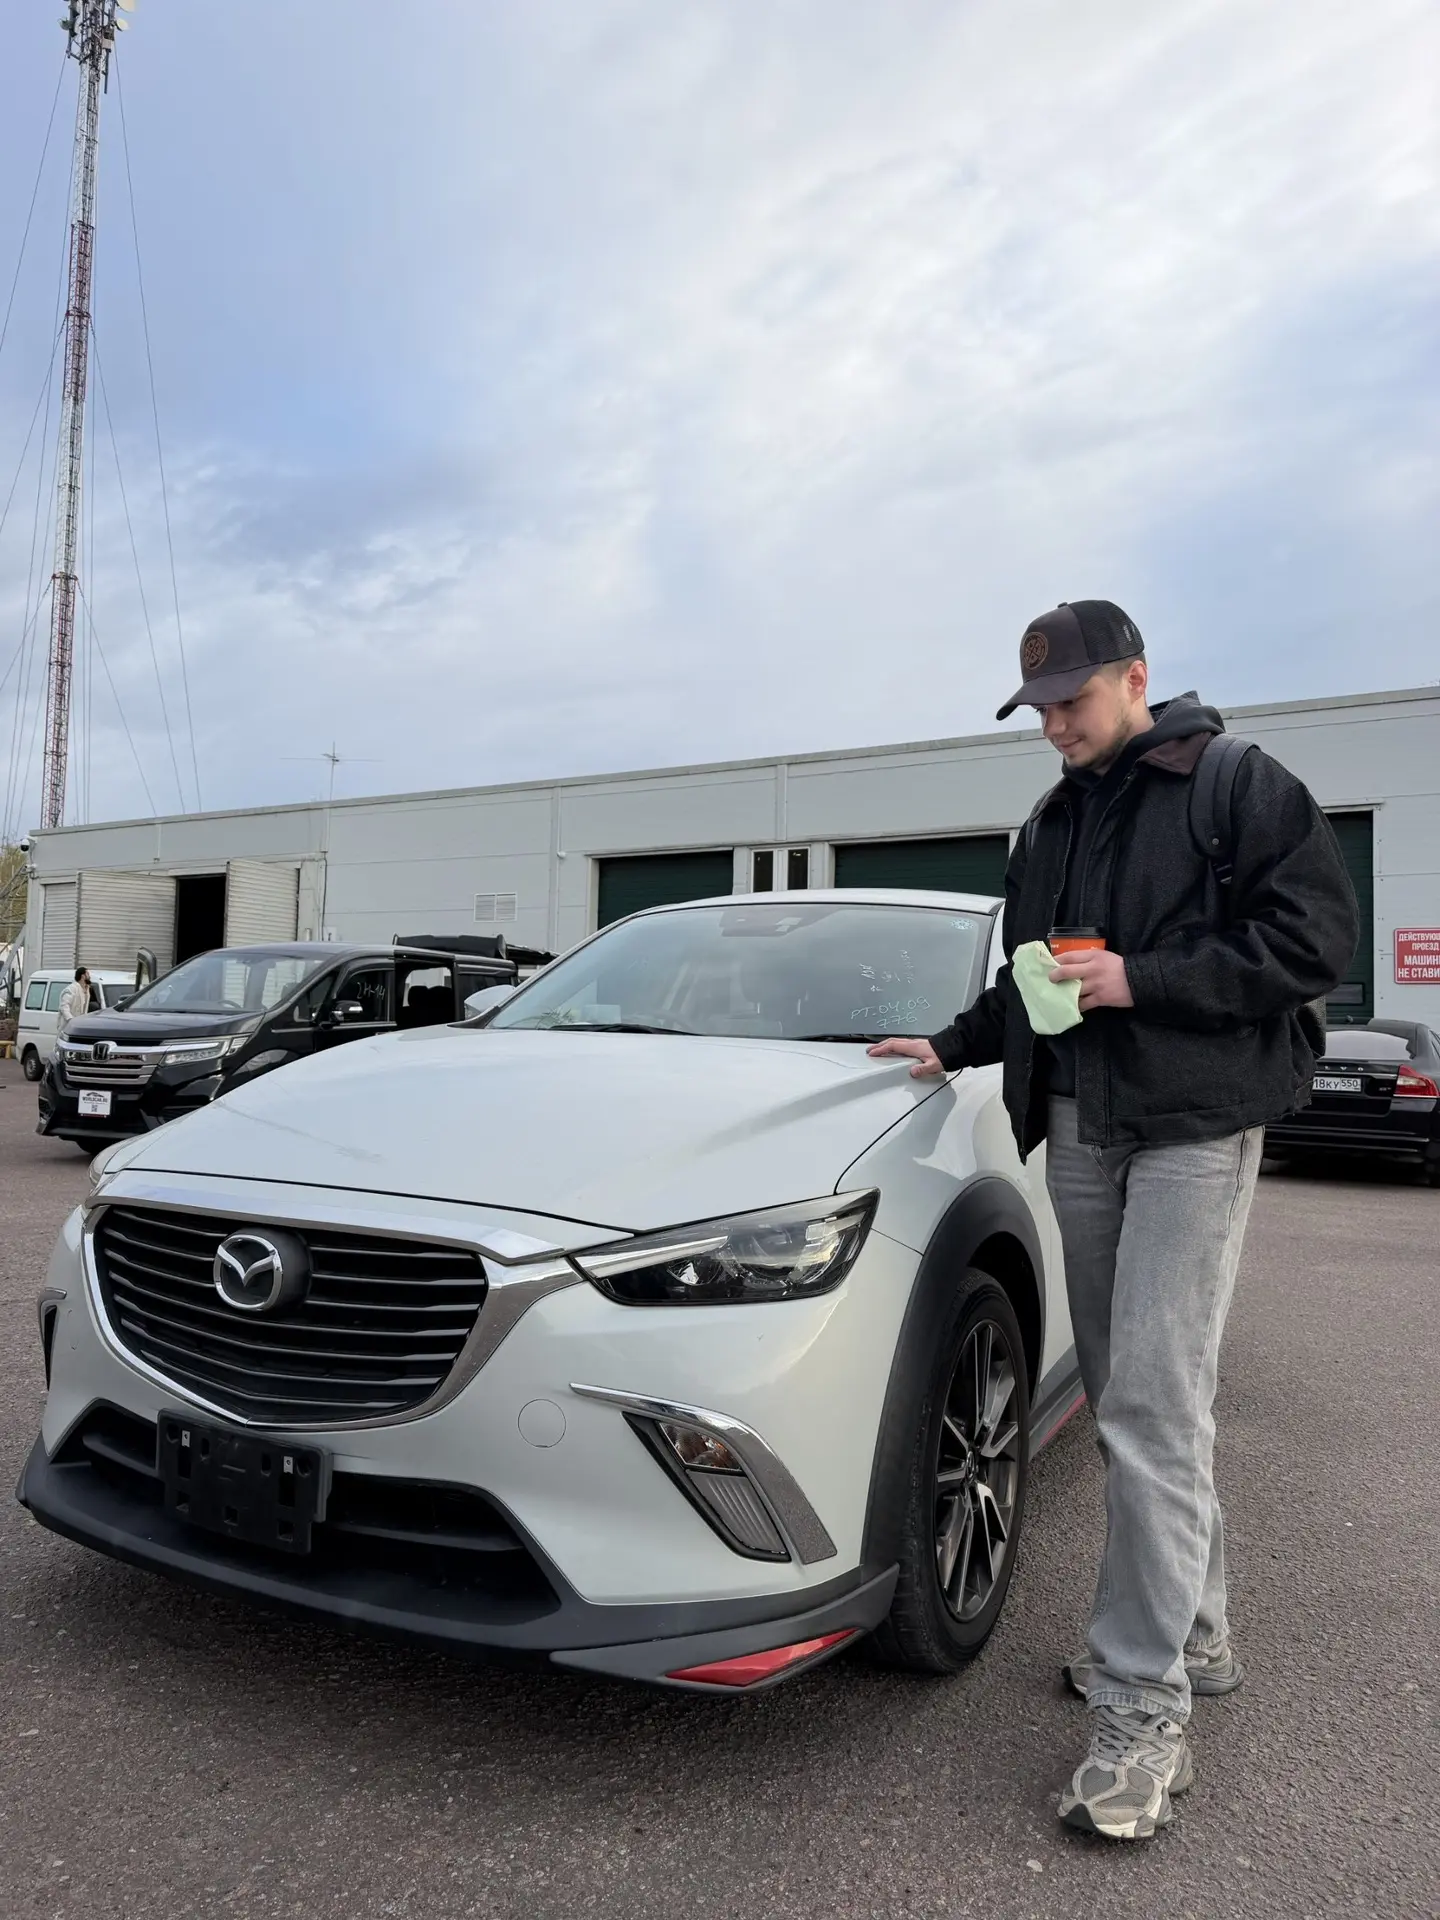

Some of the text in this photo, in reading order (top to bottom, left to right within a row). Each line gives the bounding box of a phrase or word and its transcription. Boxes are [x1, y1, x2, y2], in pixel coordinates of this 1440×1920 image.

[1412, 942, 1439, 951] ПРОЕЗД
[1404, 955, 1440, 965] МАШИН
[1398, 967, 1410, 978] НЕ
